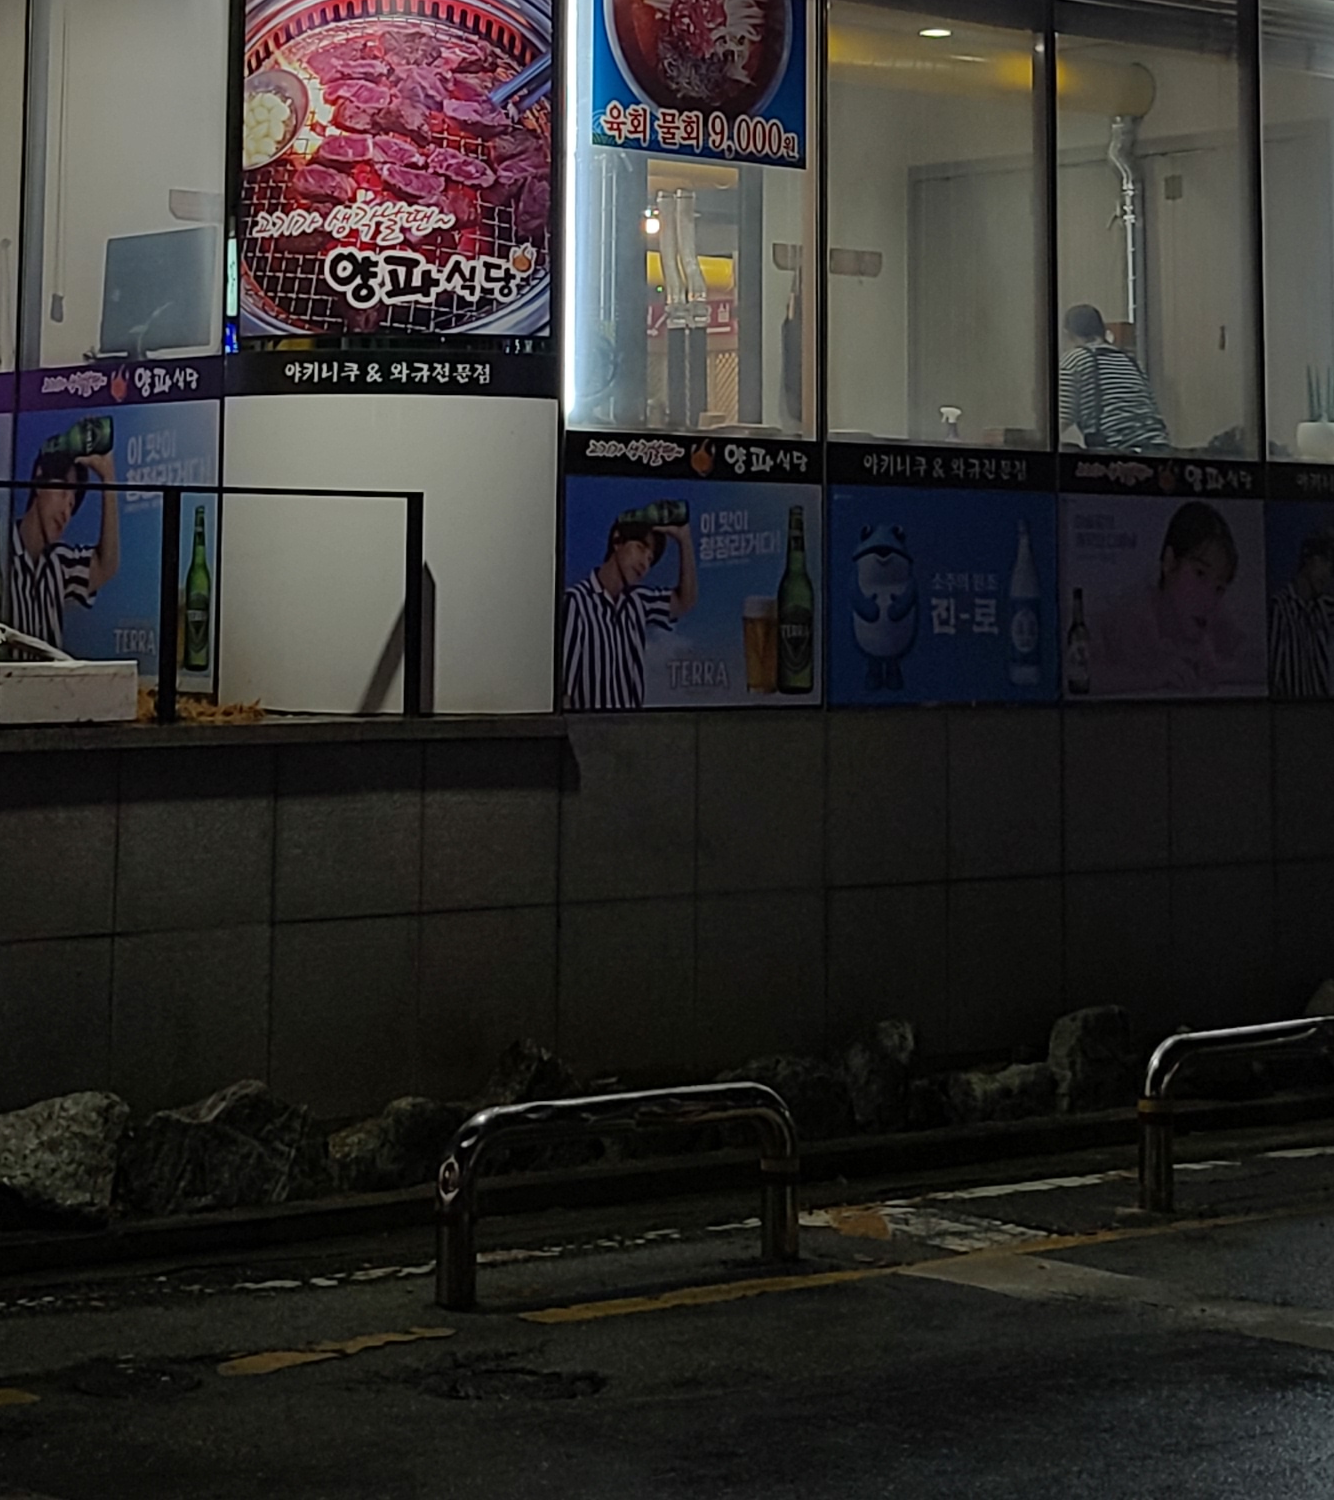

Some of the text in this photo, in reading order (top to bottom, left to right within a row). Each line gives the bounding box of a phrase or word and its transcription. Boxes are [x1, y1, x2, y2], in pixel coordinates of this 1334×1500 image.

[603, 101, 650, 148] 육회
[655, 108, 702, 153] 물회
[325, 247, 519, 308] 양파식당
[134, 367, 199, 397] 양파식당
[285, 362, 360, 383] 야키니쿠
[366, 363, 383, 383] &
[724, 443, 810, 475] 양파식당
[863, 452, 927, 478] 야키니쿠
[932, 457, 945, 479] &
[113, 628, 156, 655] TERRA
[669, 659, 730, 689] TERRA
